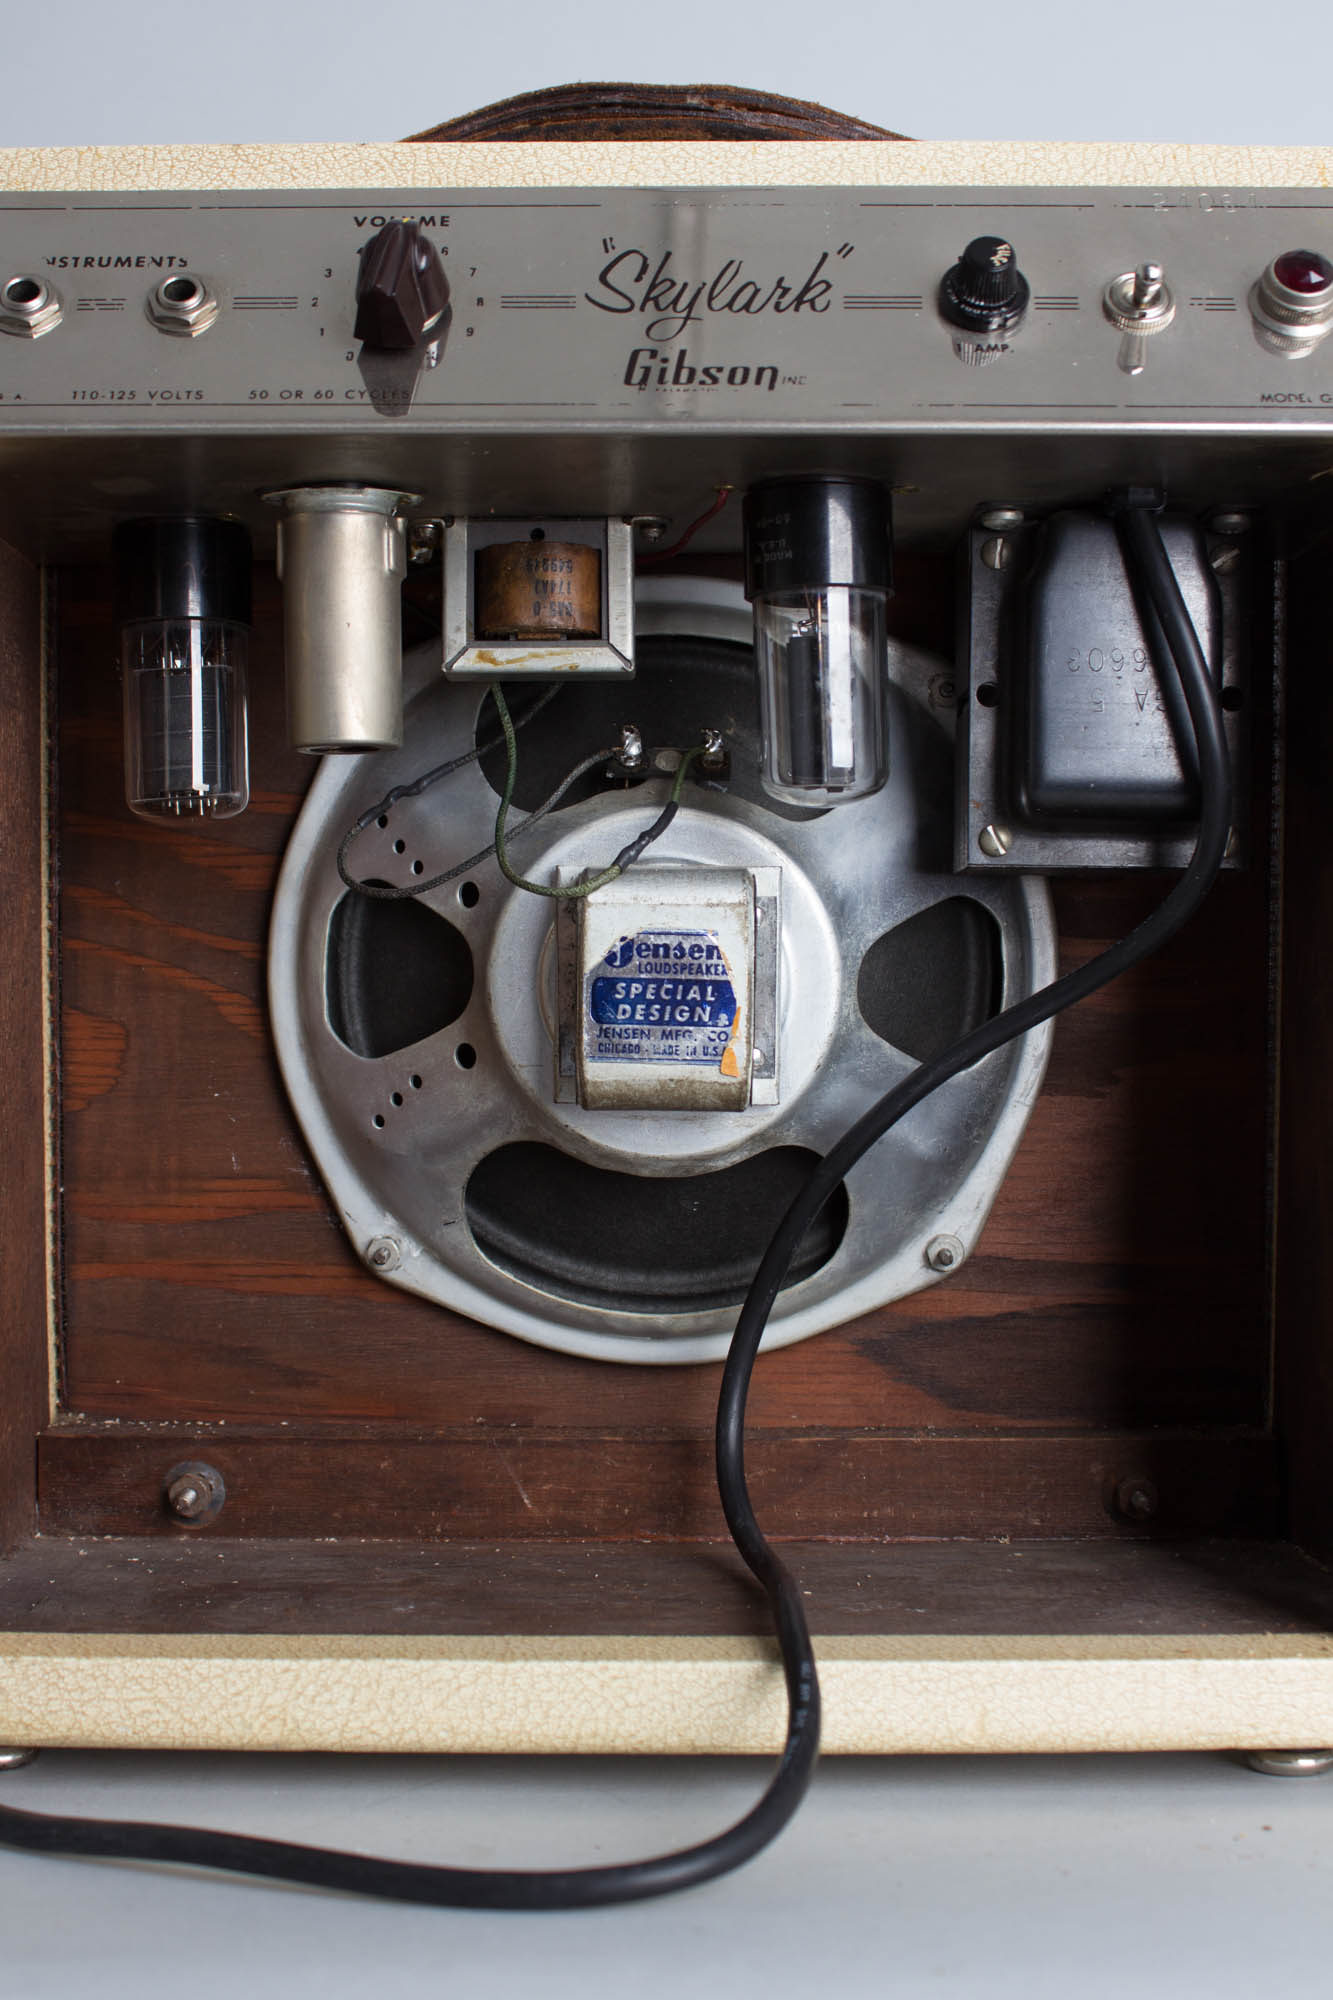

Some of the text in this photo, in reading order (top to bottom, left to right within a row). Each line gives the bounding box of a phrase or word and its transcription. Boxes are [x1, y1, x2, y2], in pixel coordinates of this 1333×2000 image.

[353, 216, 450, 227] VOME
[441, 246, 449, 256] 6
[45, 256, 188, 268] NSTRUMENTS
[324, 268, 332, 278] 3
[470, 267, 477, 277] 7
[311, 297, 319, 307] 2
[477, 297, 484, 306] 8
[319, 328, 325, 336] 1
[466, 327, 474, 337] 9
[975, 343, 1014, 353] AMP.
[623, 348, 779, 391] Gibson
[72, 390, 204, 400] 110-125 VOLTS
[249, 390, 411, 400] 50 OR 60 CYCLES
[1260, 393, 1313, 403] MODEL
[1091, 688, 1104, 713] 5
[614, 982, 716, 1001] SPECIAL
[616, 1003, 712, 1023] DESIGN
[596, 1026, 651, 1041] JENSEN
[598, 1043, 641, 1055] CHICAGO
[702, 1045, 727, 1056] U.S.
